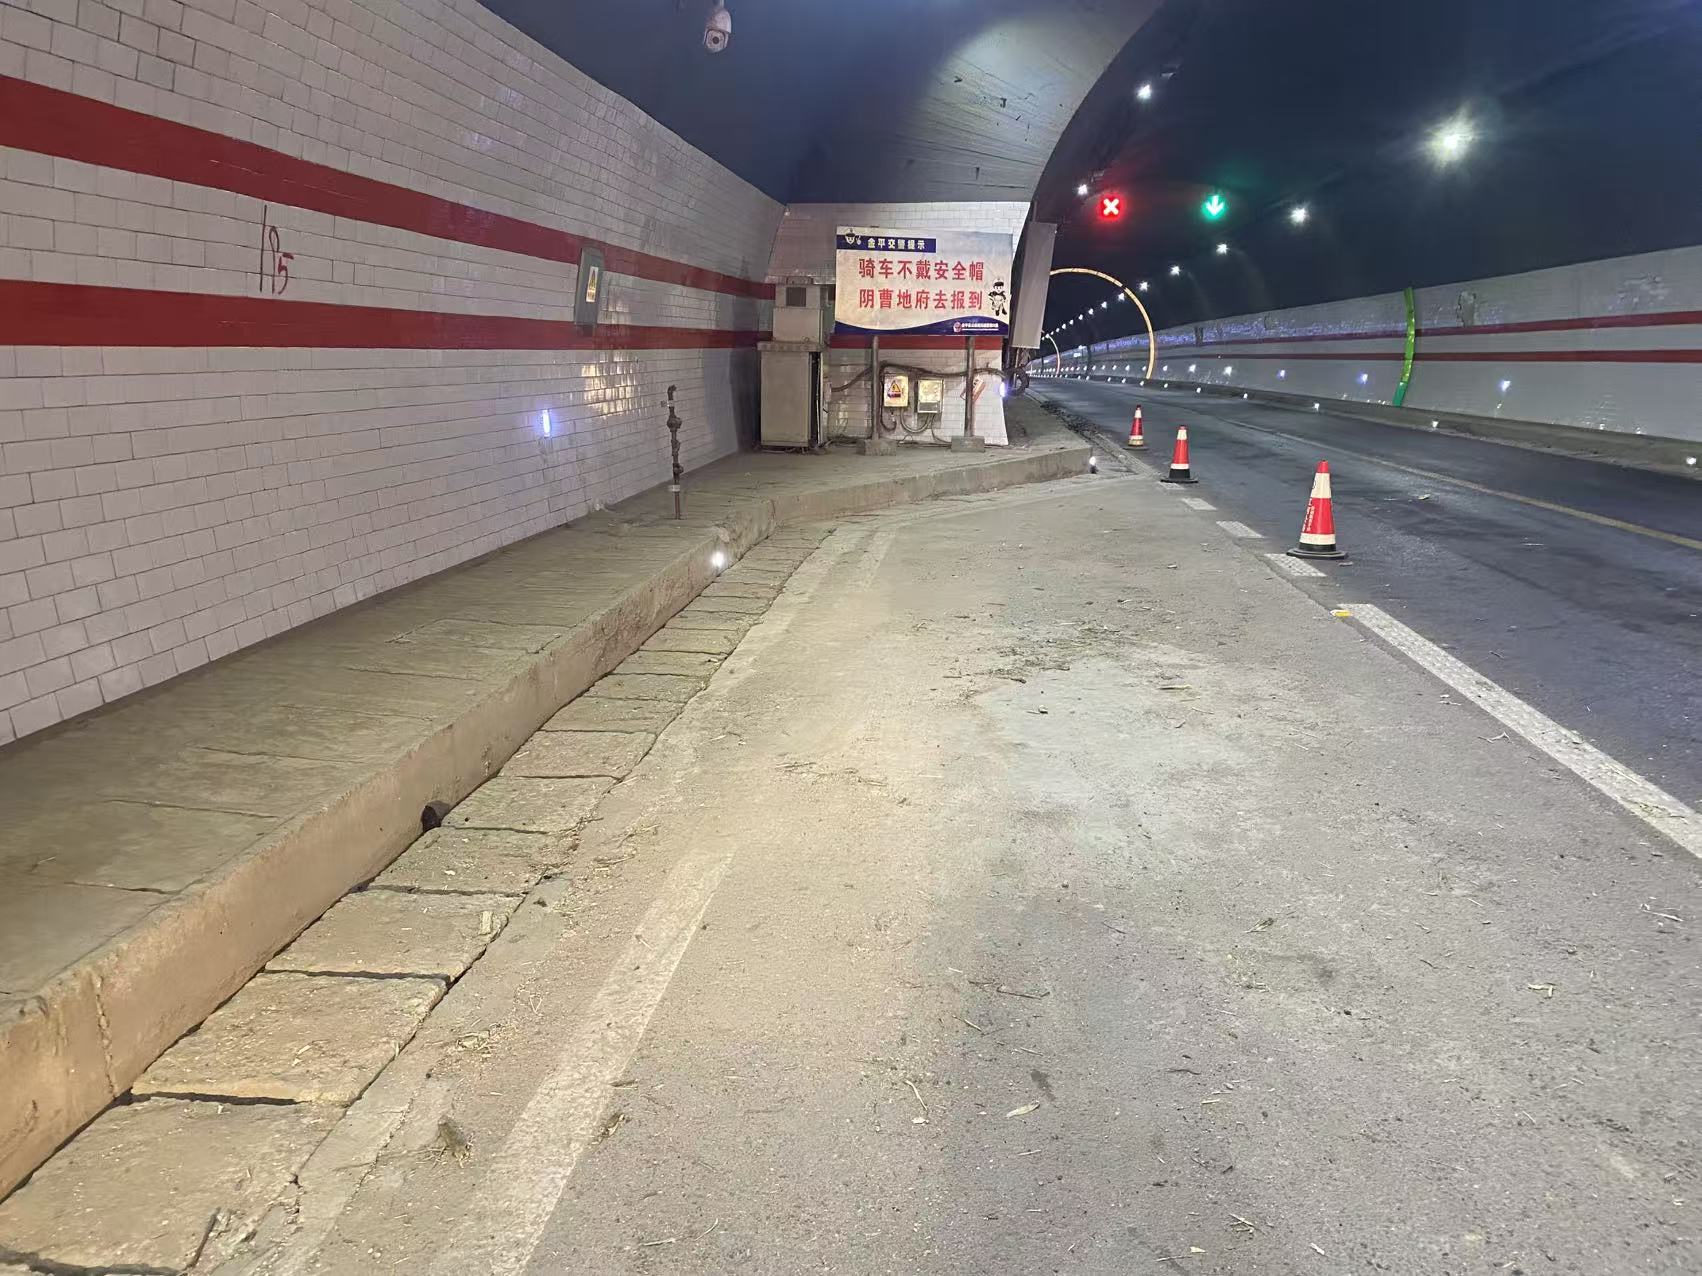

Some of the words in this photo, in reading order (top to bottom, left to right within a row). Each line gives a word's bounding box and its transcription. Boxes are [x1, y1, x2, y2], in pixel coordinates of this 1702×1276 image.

[867, 237, 926, 250] 金平交警提示
[858, 257, 985, 282] 骑车不戴安全帽
[859, 288, 983, 311] 阴曹地府去报到
